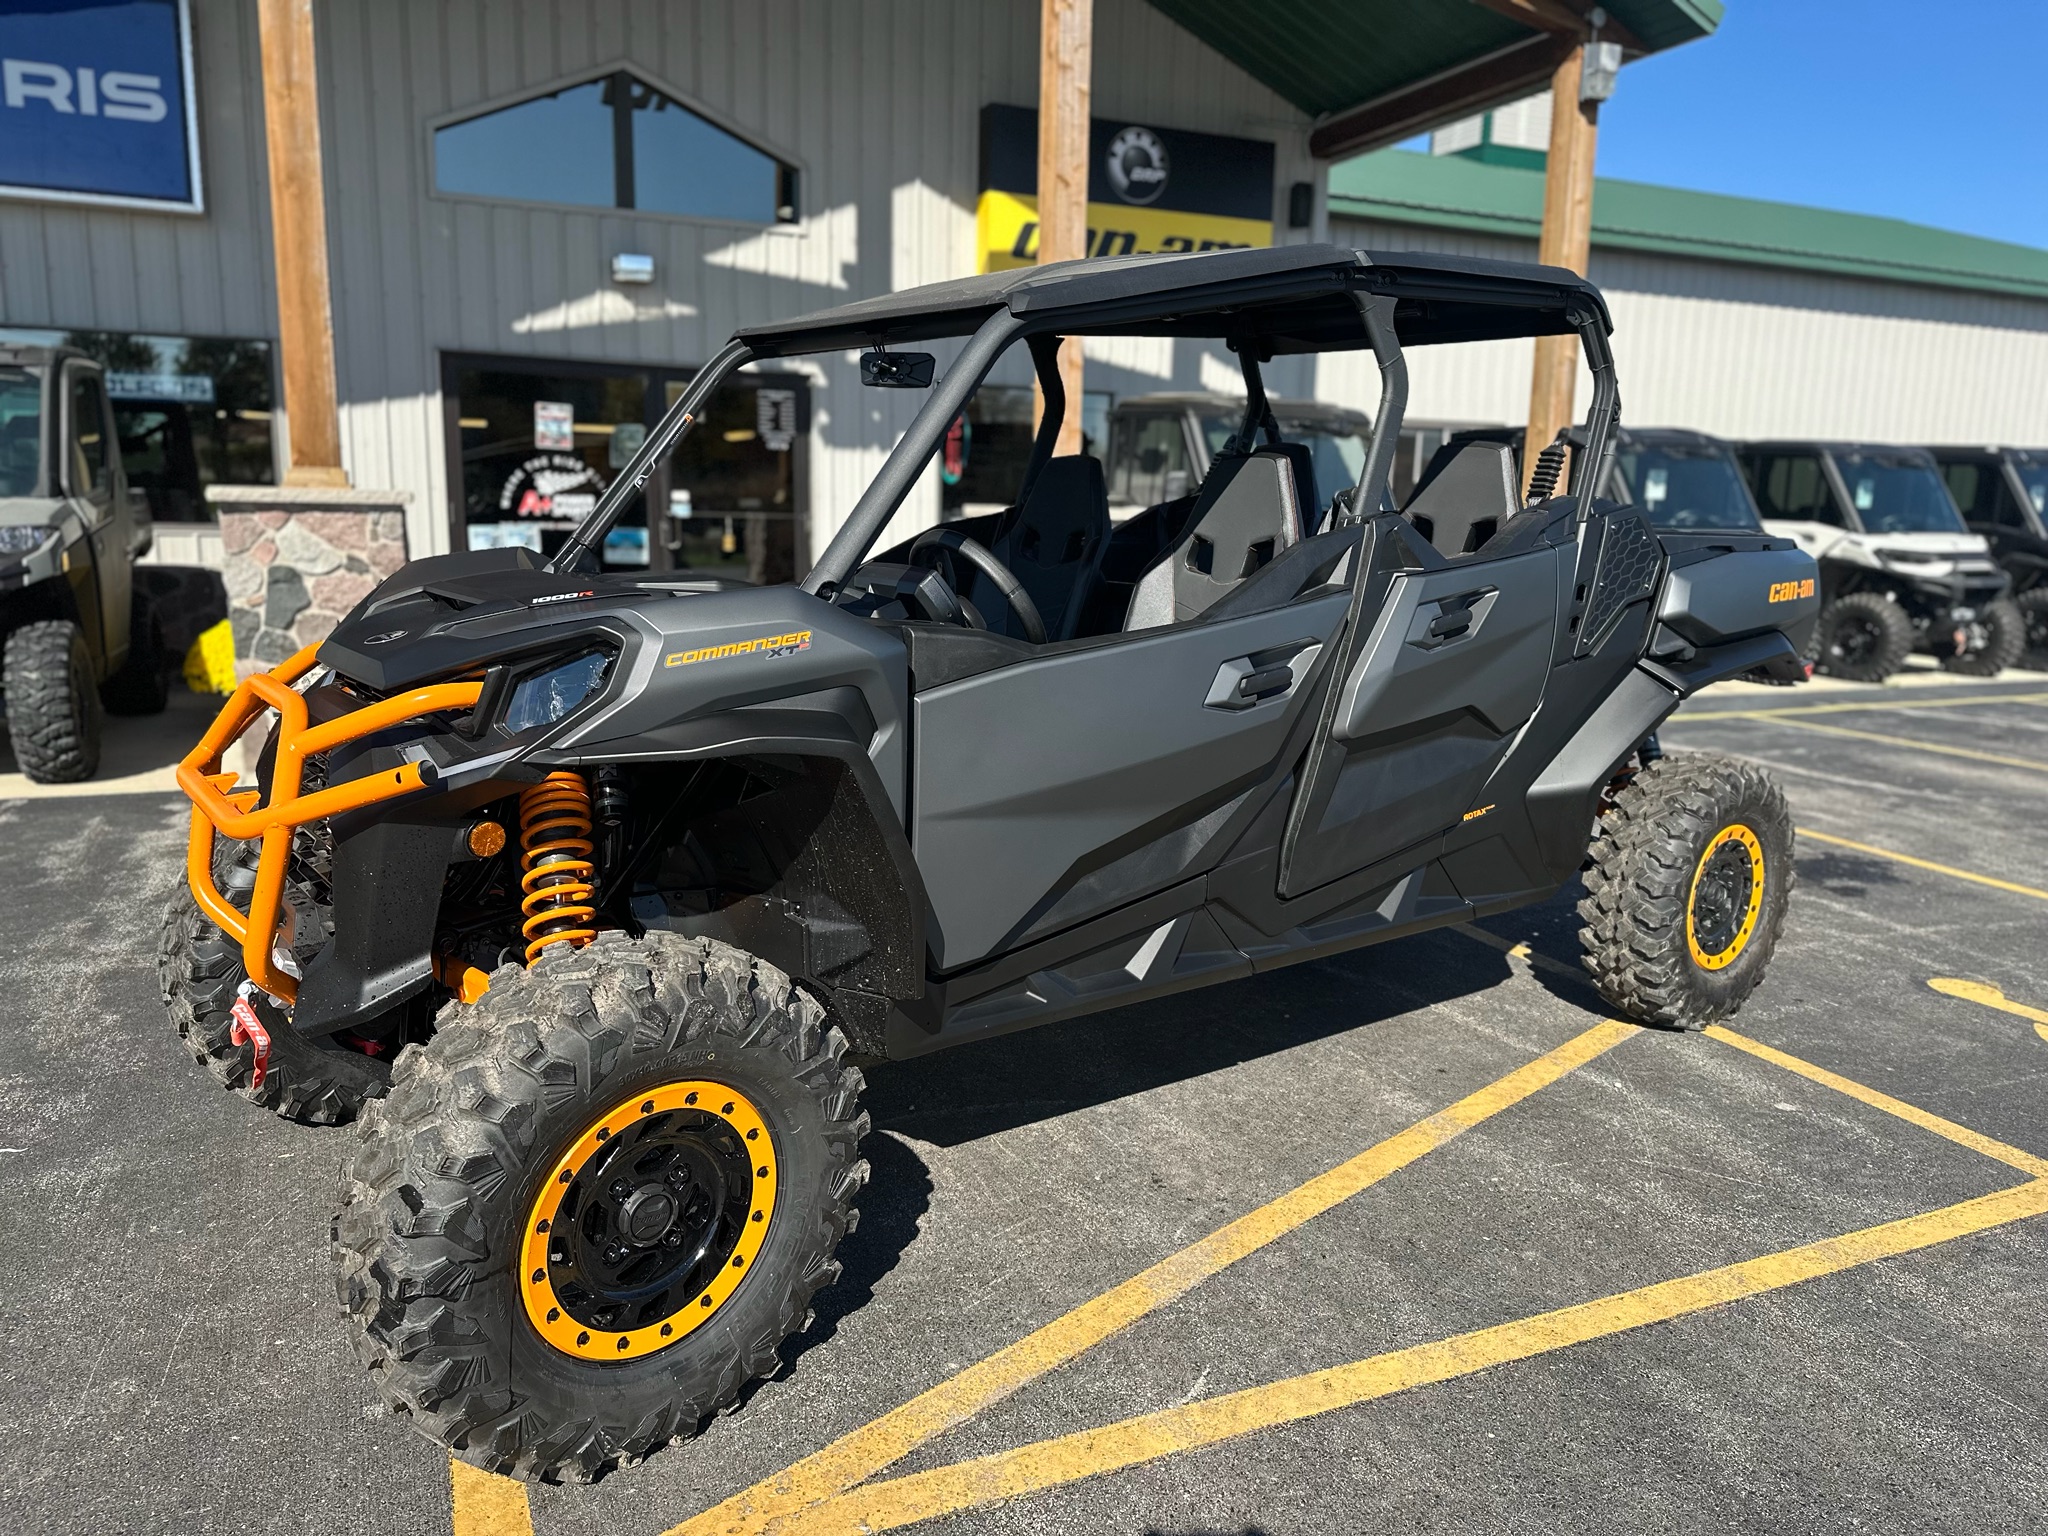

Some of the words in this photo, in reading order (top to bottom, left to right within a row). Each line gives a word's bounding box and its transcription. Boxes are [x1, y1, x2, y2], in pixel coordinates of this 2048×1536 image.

[3, 57, 168, 123] RIS
[532, 590, 594, 604] 1000R
[1768, 578, 1815, 603] can-am
[665, 630, 812, 667] COMMANDER
[767, 642, 810, 659] XTP
[1463, 807, 1487, 821] ROTAX
